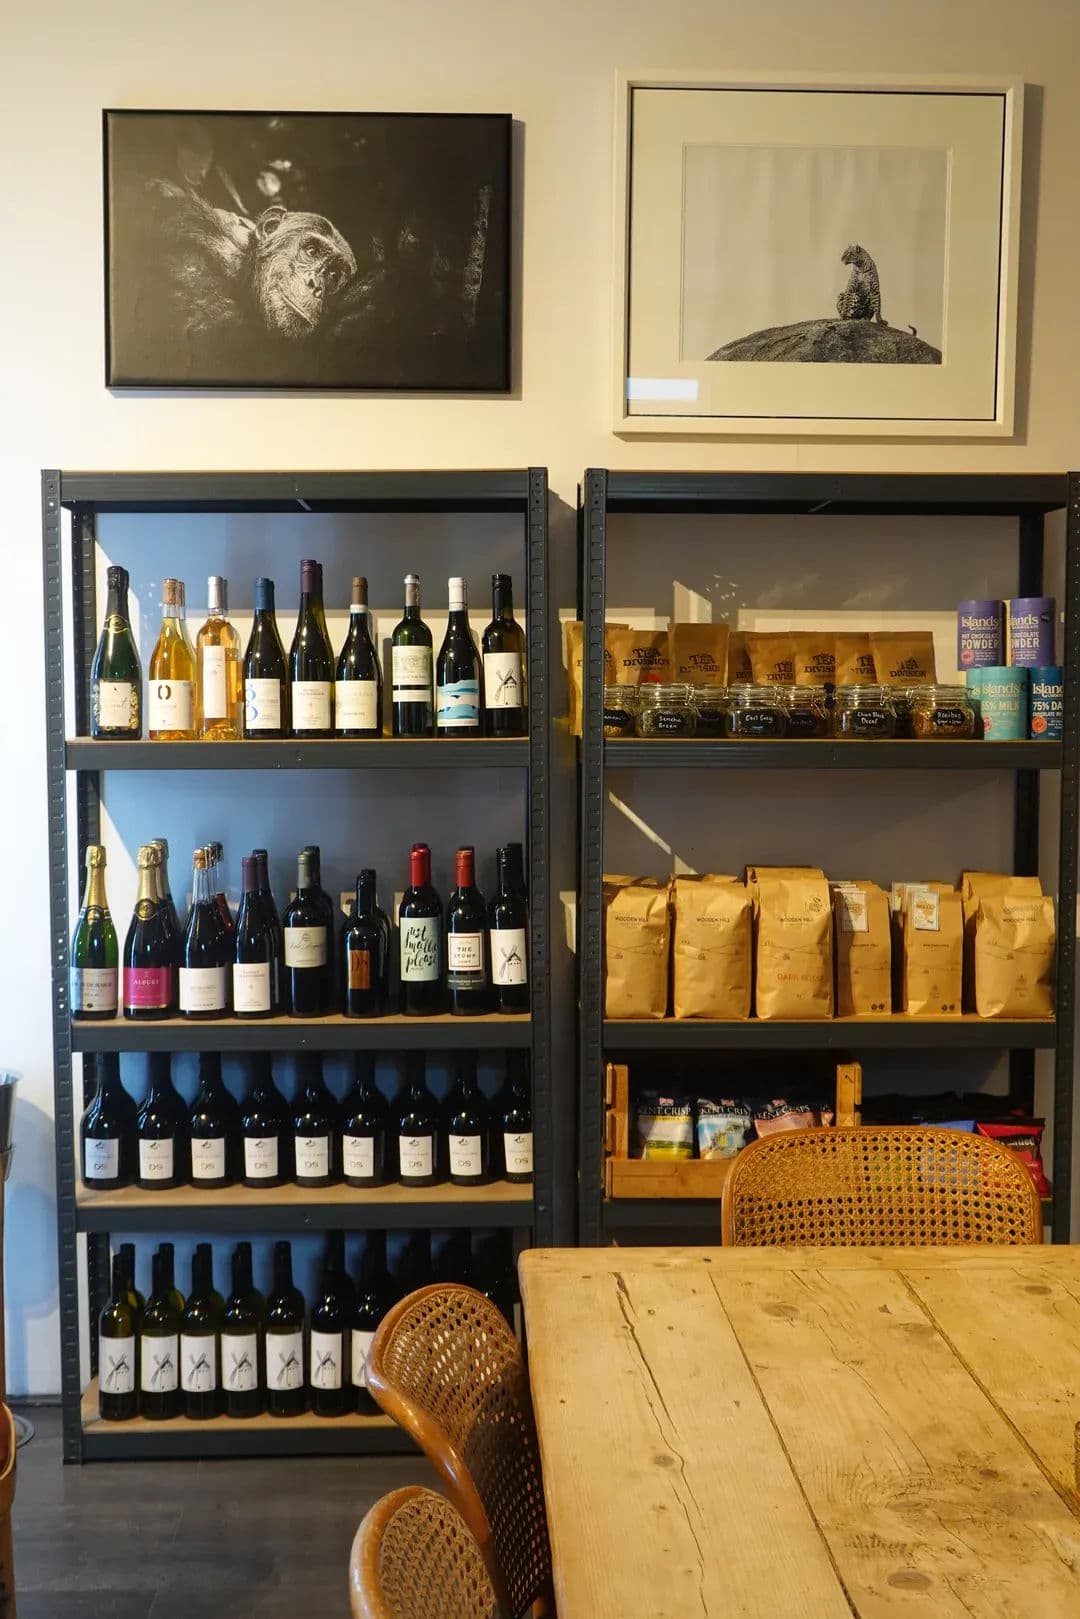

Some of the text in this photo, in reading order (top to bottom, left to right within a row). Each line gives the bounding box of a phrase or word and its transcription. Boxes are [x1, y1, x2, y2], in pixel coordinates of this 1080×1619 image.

[961, 615, 999, 628] Islands
[961, 639, 1000, 649] POWDER
[632, 647, 662, 658] TEA
[623, 658, 671, 667] DIVISION
[689, 653, 715, 664] TEA
[897, 656, 919, 670] TEA
[889, 670, 926, 678] DIVISION
[1033, 701, 1049, 711] 75%
[659, 715, 682, 723] Sencha
[745, 714, 774, 724] Earl Grey
[861, 717, 879, 725] Decaf
[615, 915, 638, 923] WOODEN
[406, 925, 427, 948] just
